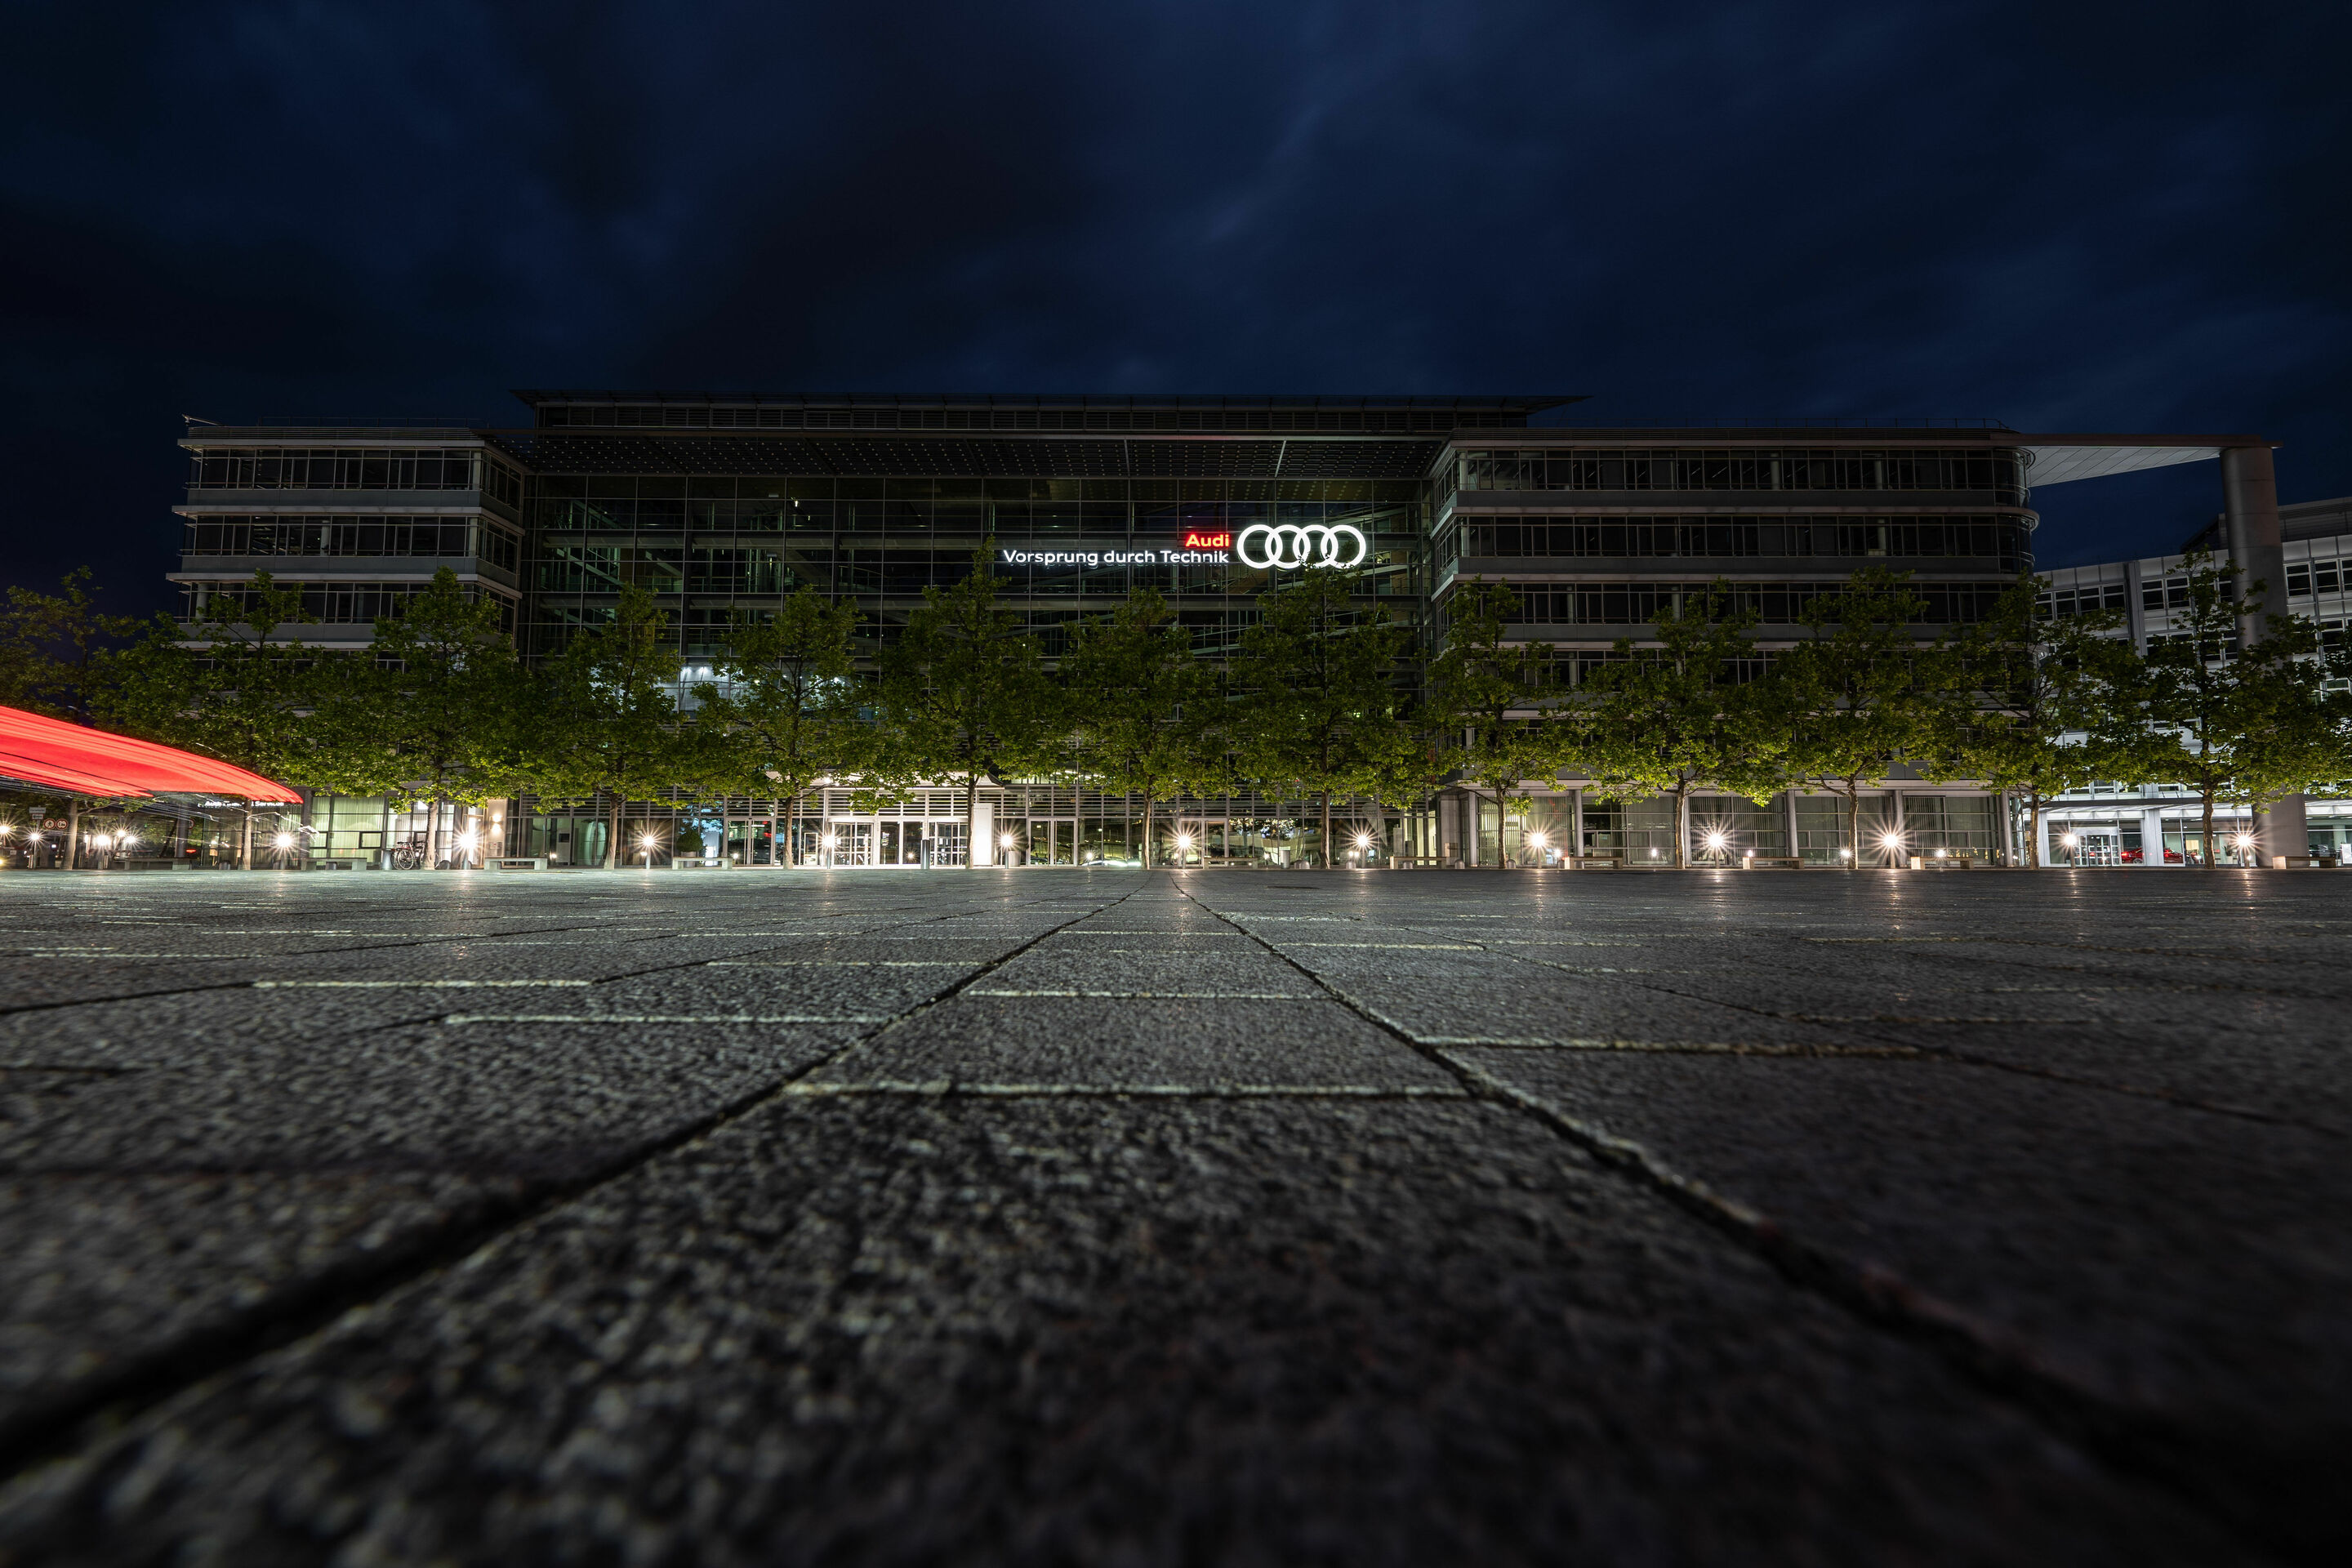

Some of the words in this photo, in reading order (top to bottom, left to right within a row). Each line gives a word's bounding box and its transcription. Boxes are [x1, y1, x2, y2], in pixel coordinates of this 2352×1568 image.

[1185, 533, 1230, 547] Audi
[1003, 550, 1098, 566] Vorsprung
[1103, 550, 1156, 563] durch
[1160, 550, 1229, 564] Technik
